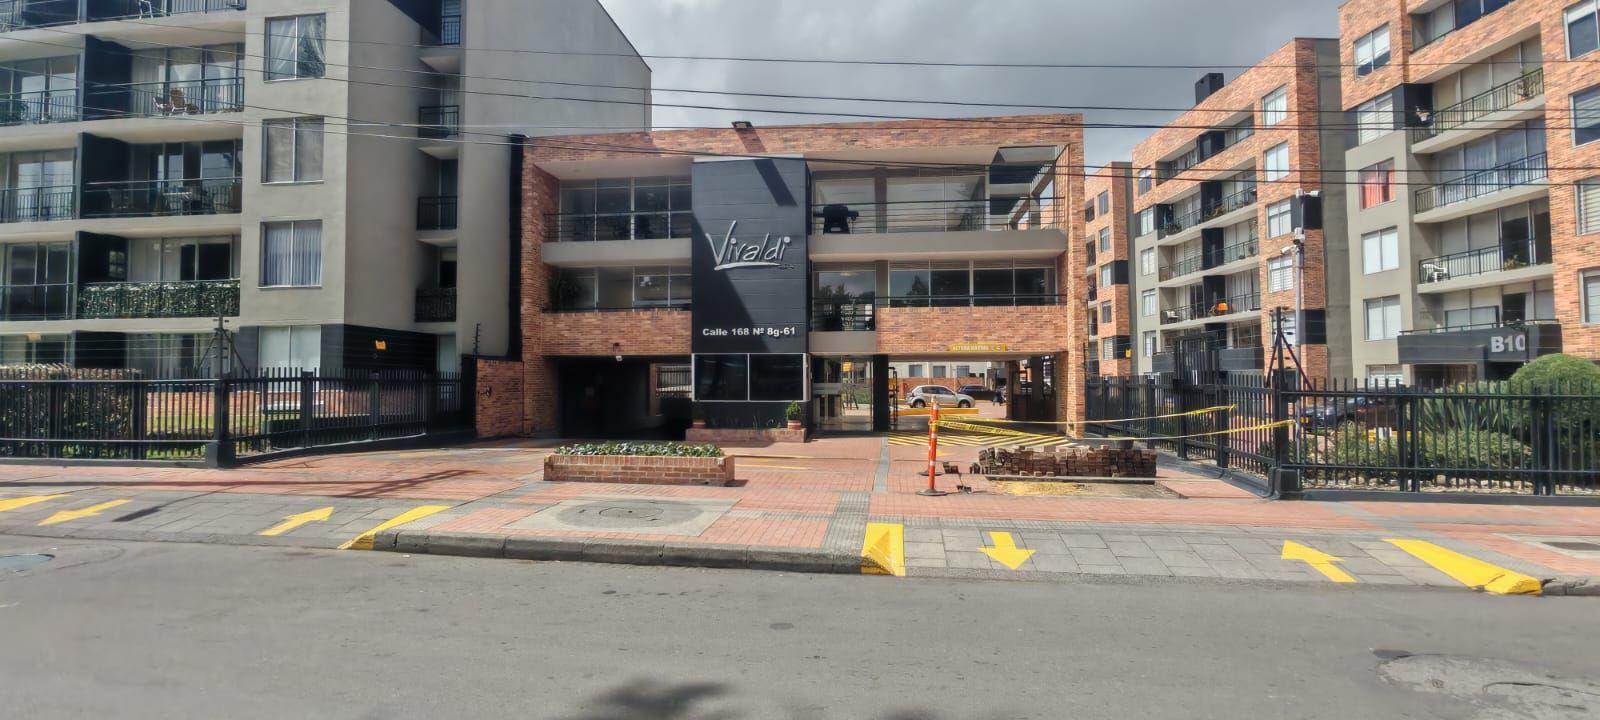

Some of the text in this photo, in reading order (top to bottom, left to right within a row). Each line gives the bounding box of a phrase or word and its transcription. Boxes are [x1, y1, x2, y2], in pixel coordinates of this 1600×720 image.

[705, 220, 791, 266] Vivaldi
[702, 328, 728, 336] Calle
[731, 327, 750, 336] 168
[767, 327, 795, 337] 8g-61
[1491, 335, 1526, 352] B10
